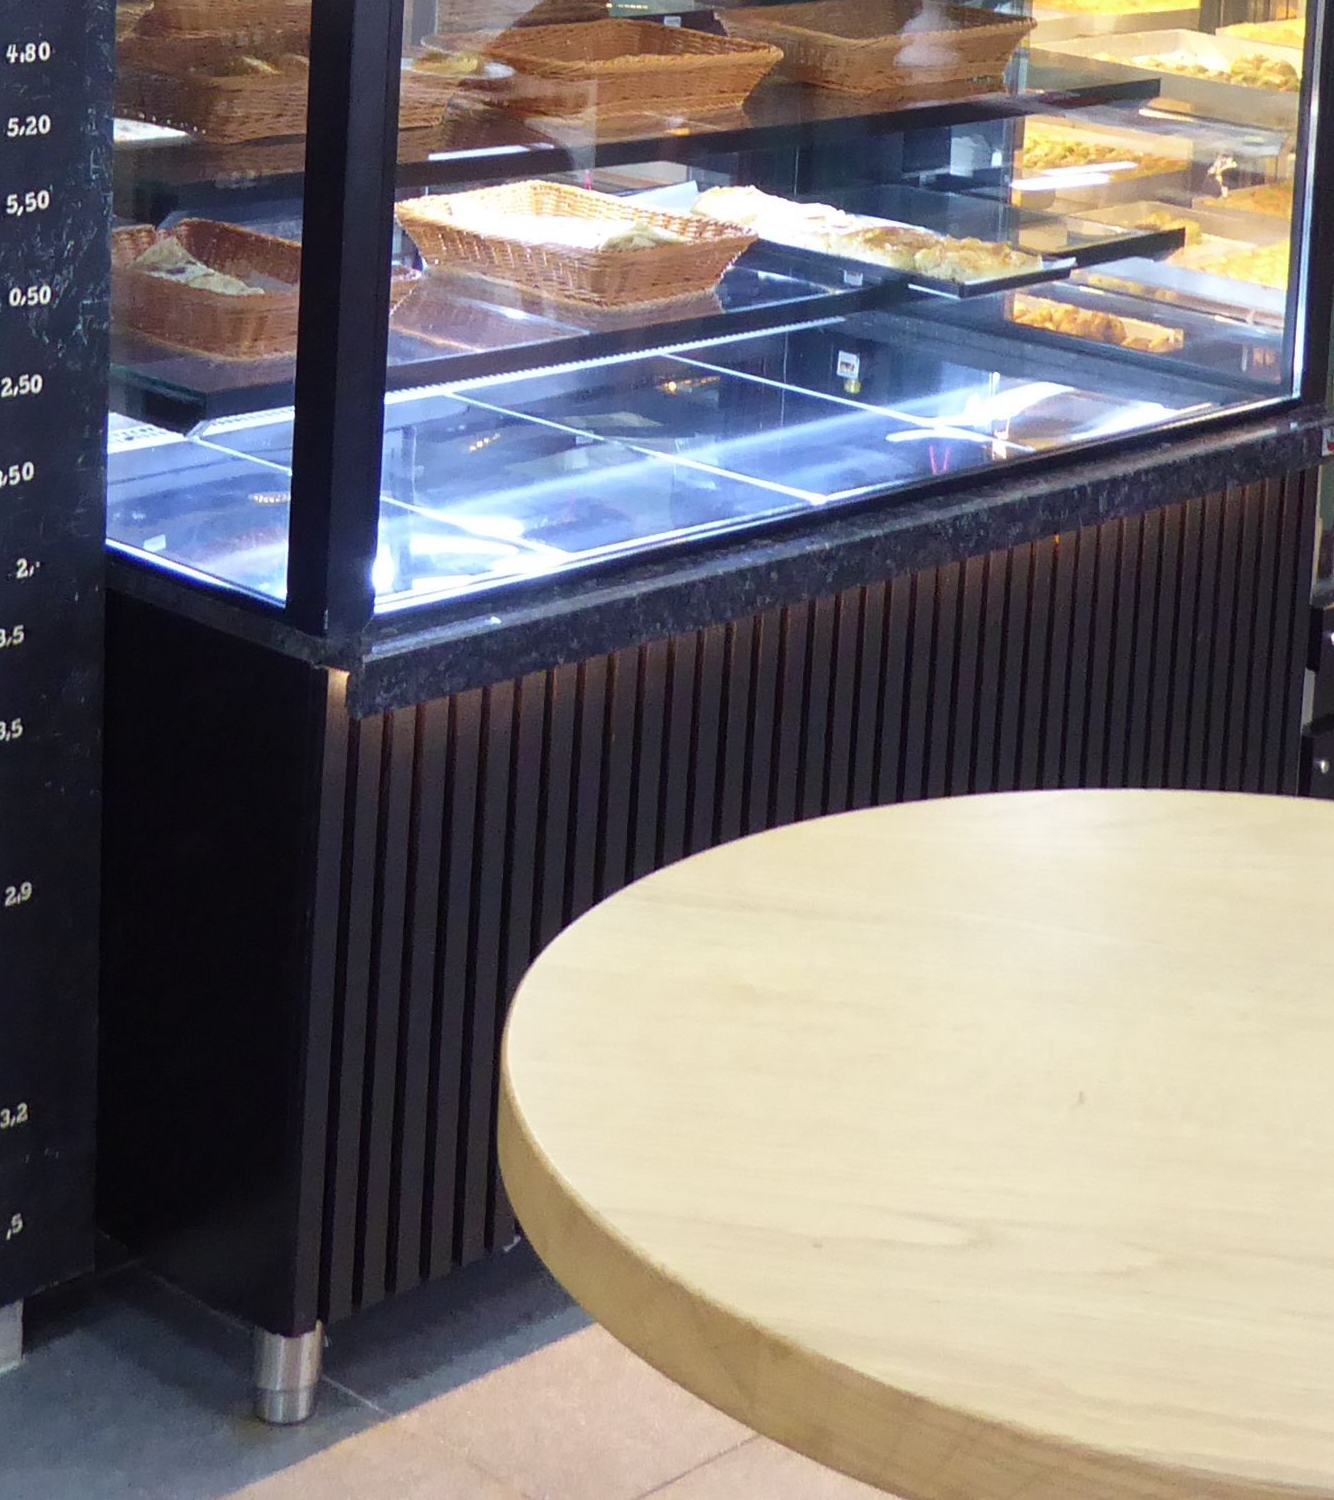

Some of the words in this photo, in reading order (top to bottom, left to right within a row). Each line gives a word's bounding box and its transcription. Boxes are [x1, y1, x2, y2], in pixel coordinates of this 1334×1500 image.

[6, 41, 52, 64] 4,80
[7, 114, 52, 138] 5,20
[6, 189, 51, 216] 5,50
[8, 284, 53, 307] 0,50
[0, 373, 44, 398] 2,50
[4, 881, 33, 906] 2,9
[0, 1103, 29, 1129] 3,2
